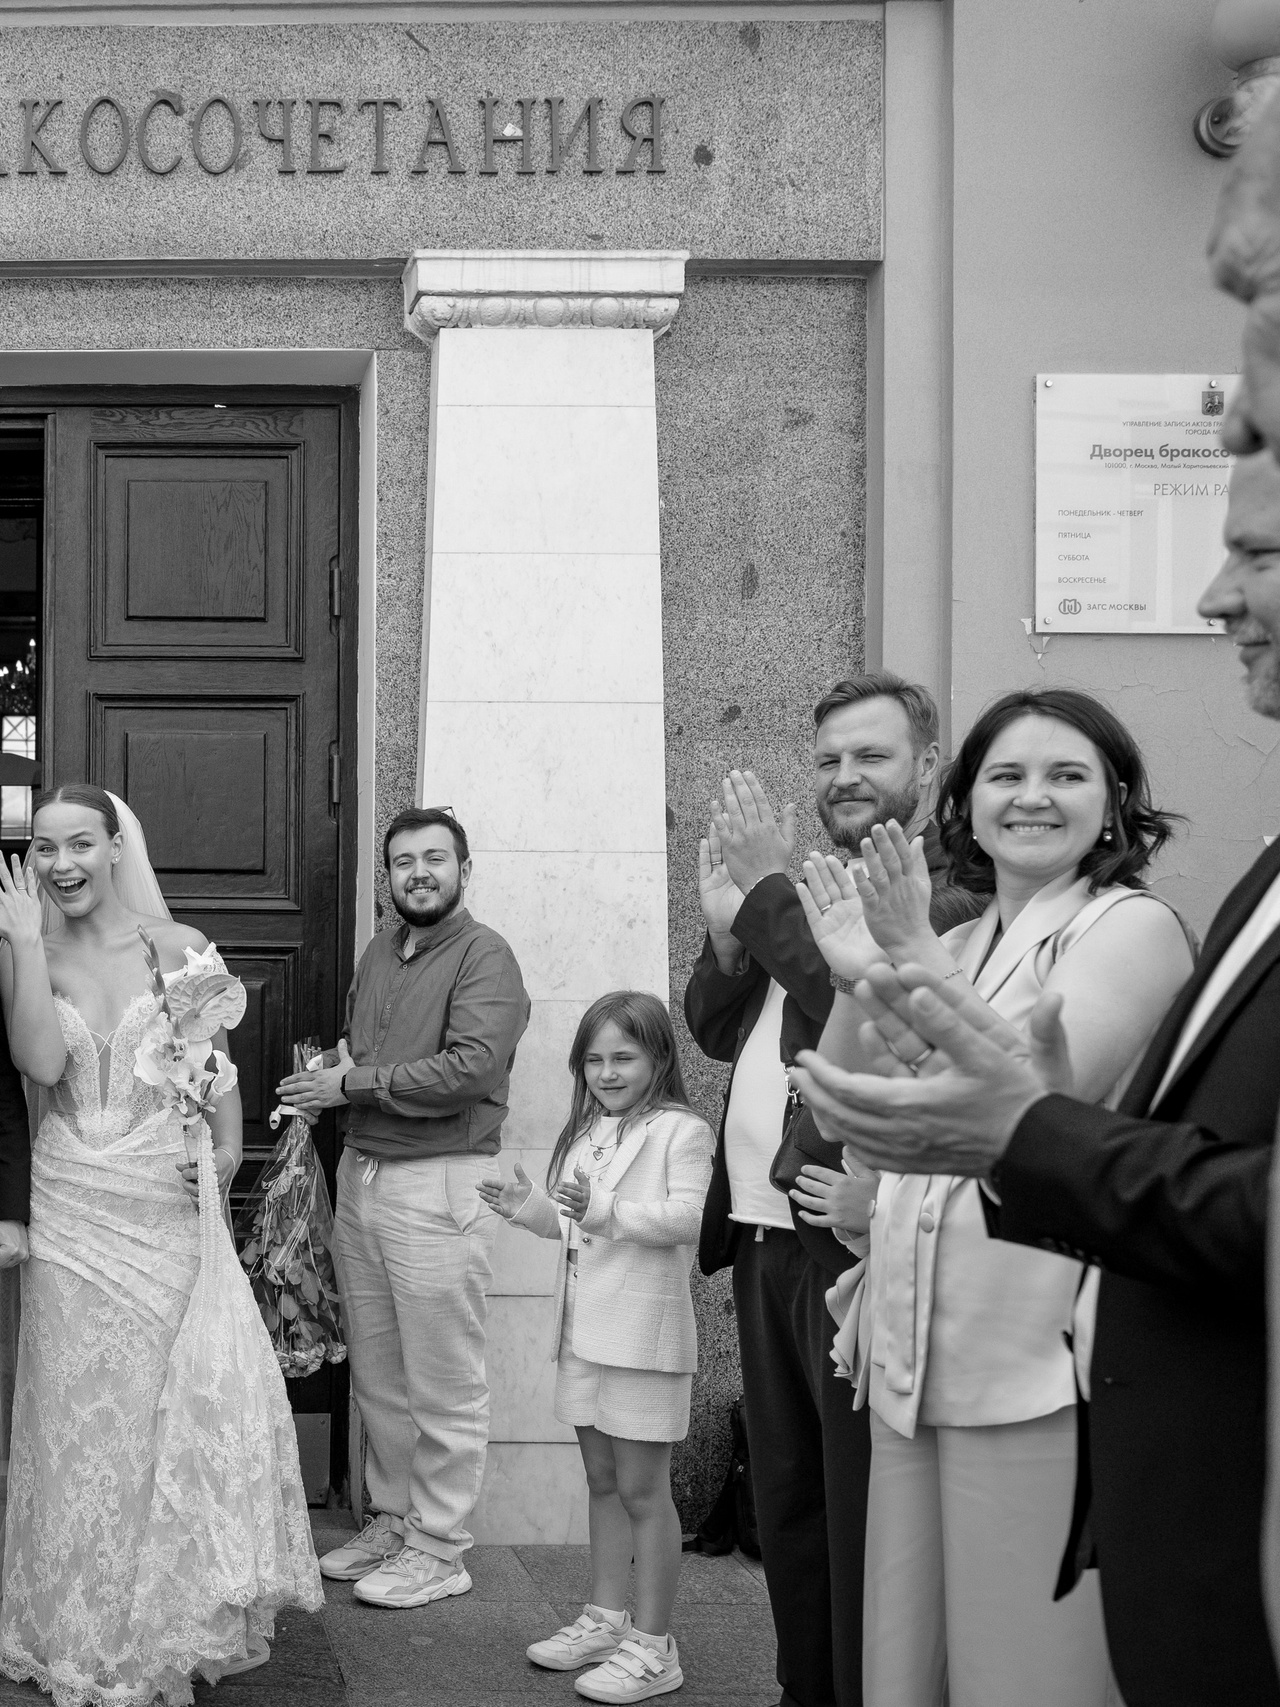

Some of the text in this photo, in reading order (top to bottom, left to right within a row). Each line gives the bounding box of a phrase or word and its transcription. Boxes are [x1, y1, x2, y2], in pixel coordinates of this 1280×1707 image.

[1090, 443, 1231, 461] Дворец бракосо
[1153, 484, 1230, 496] РЕЖИМ РА
